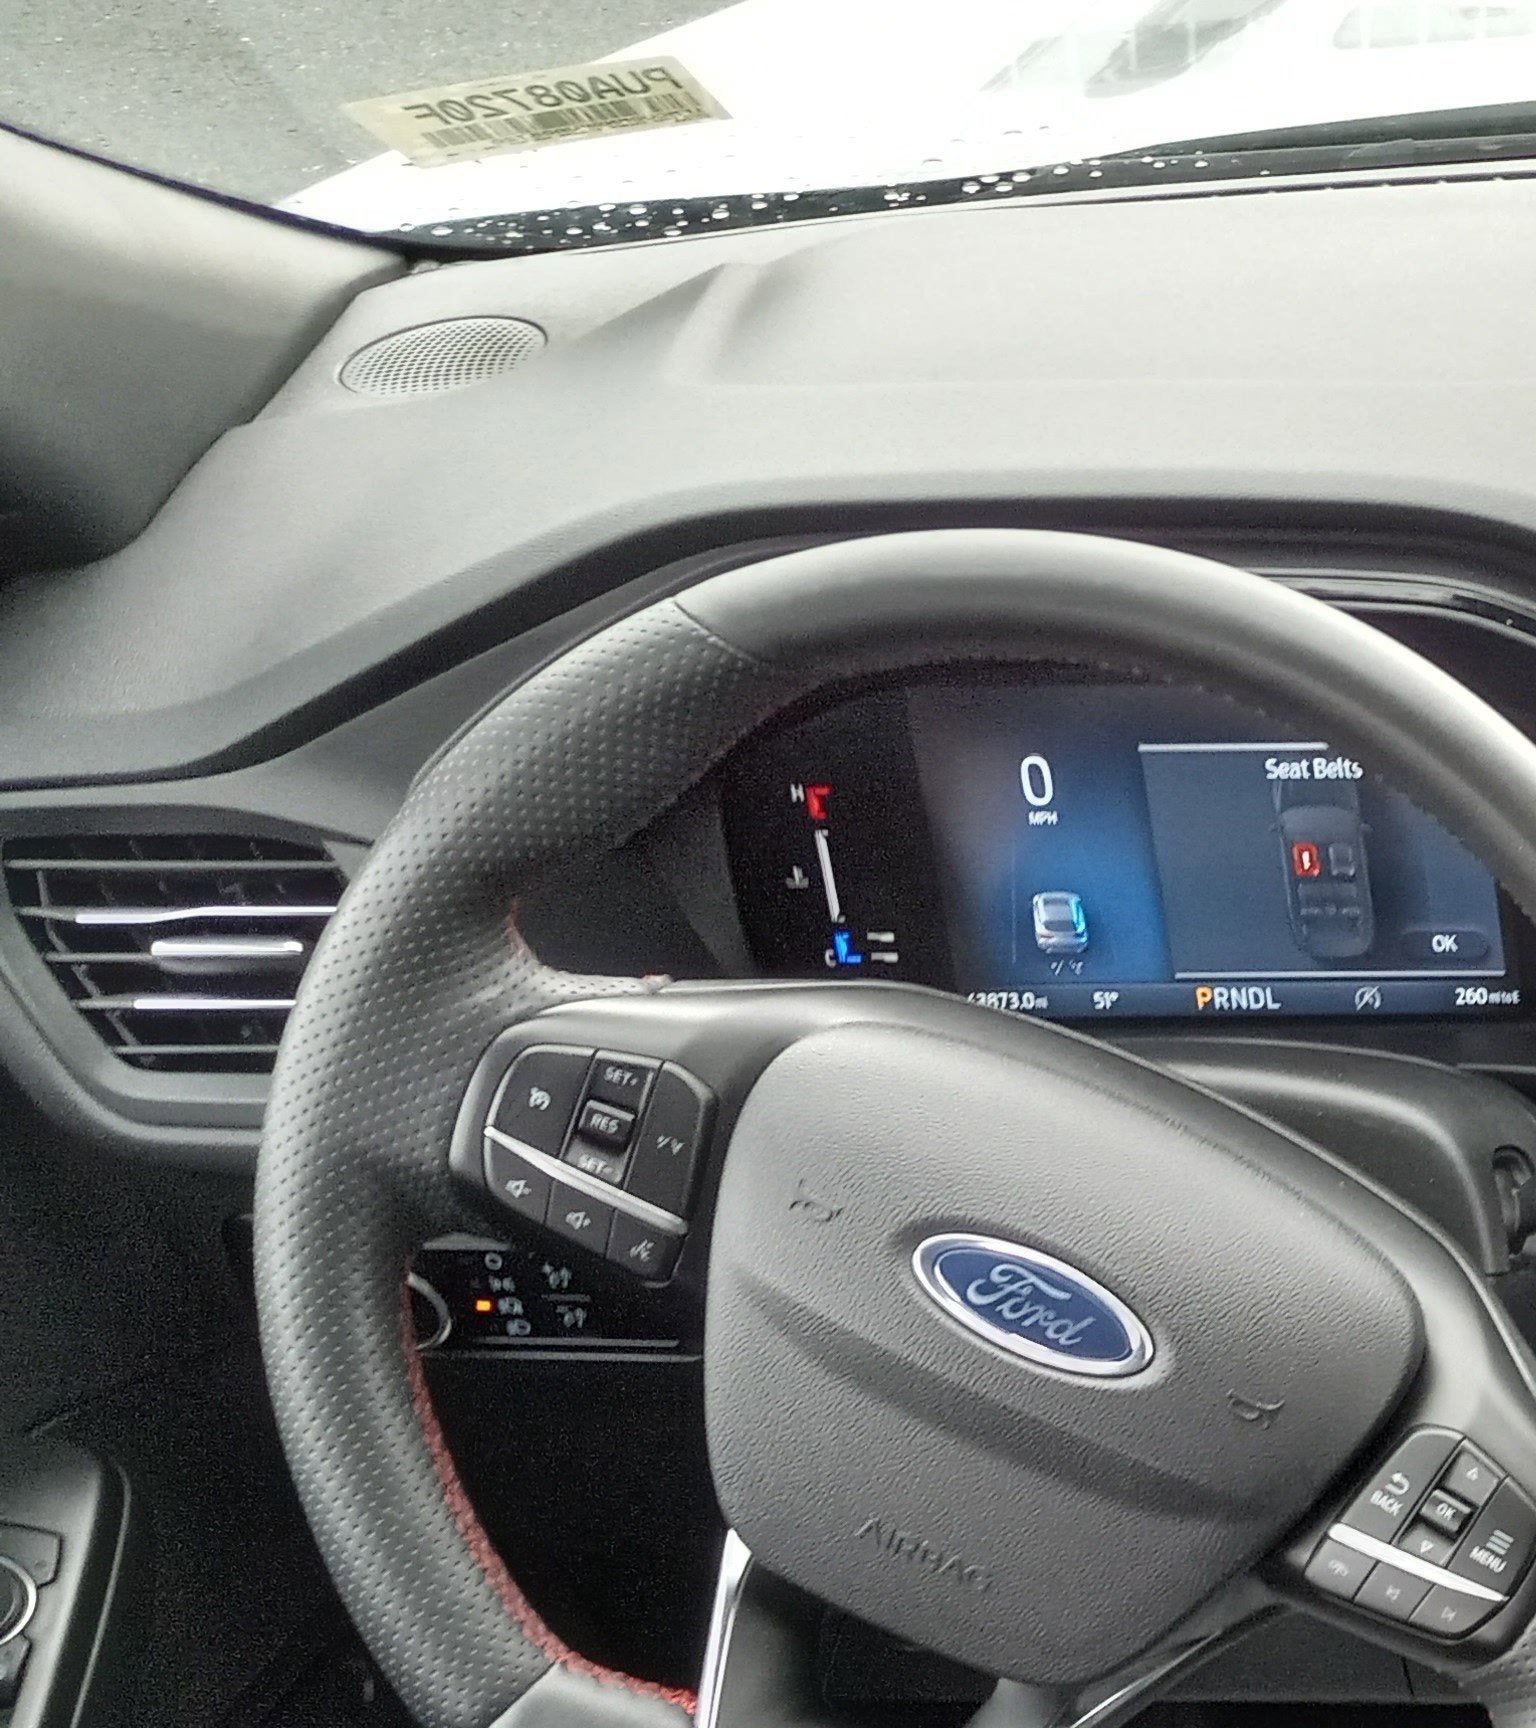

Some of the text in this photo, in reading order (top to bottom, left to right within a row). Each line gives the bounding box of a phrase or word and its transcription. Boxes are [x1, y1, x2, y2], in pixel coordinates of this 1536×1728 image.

[1264, 757, 1363, 780] Seat Belts
[1028, 811, 1058, 827] MPH
[1431, 934, 1459, 954] OK
[1195, 985, 1282, 1011] PRNDL
[1455, 987, 1488, 1006] 260
[965, 1263, 1096, 1347] Ford
[1369, 1489, 1404, 1517] BACK
[1435, 1502, 1456, 1521] OK
[1468, 1545, 1508, 1574] MENU
